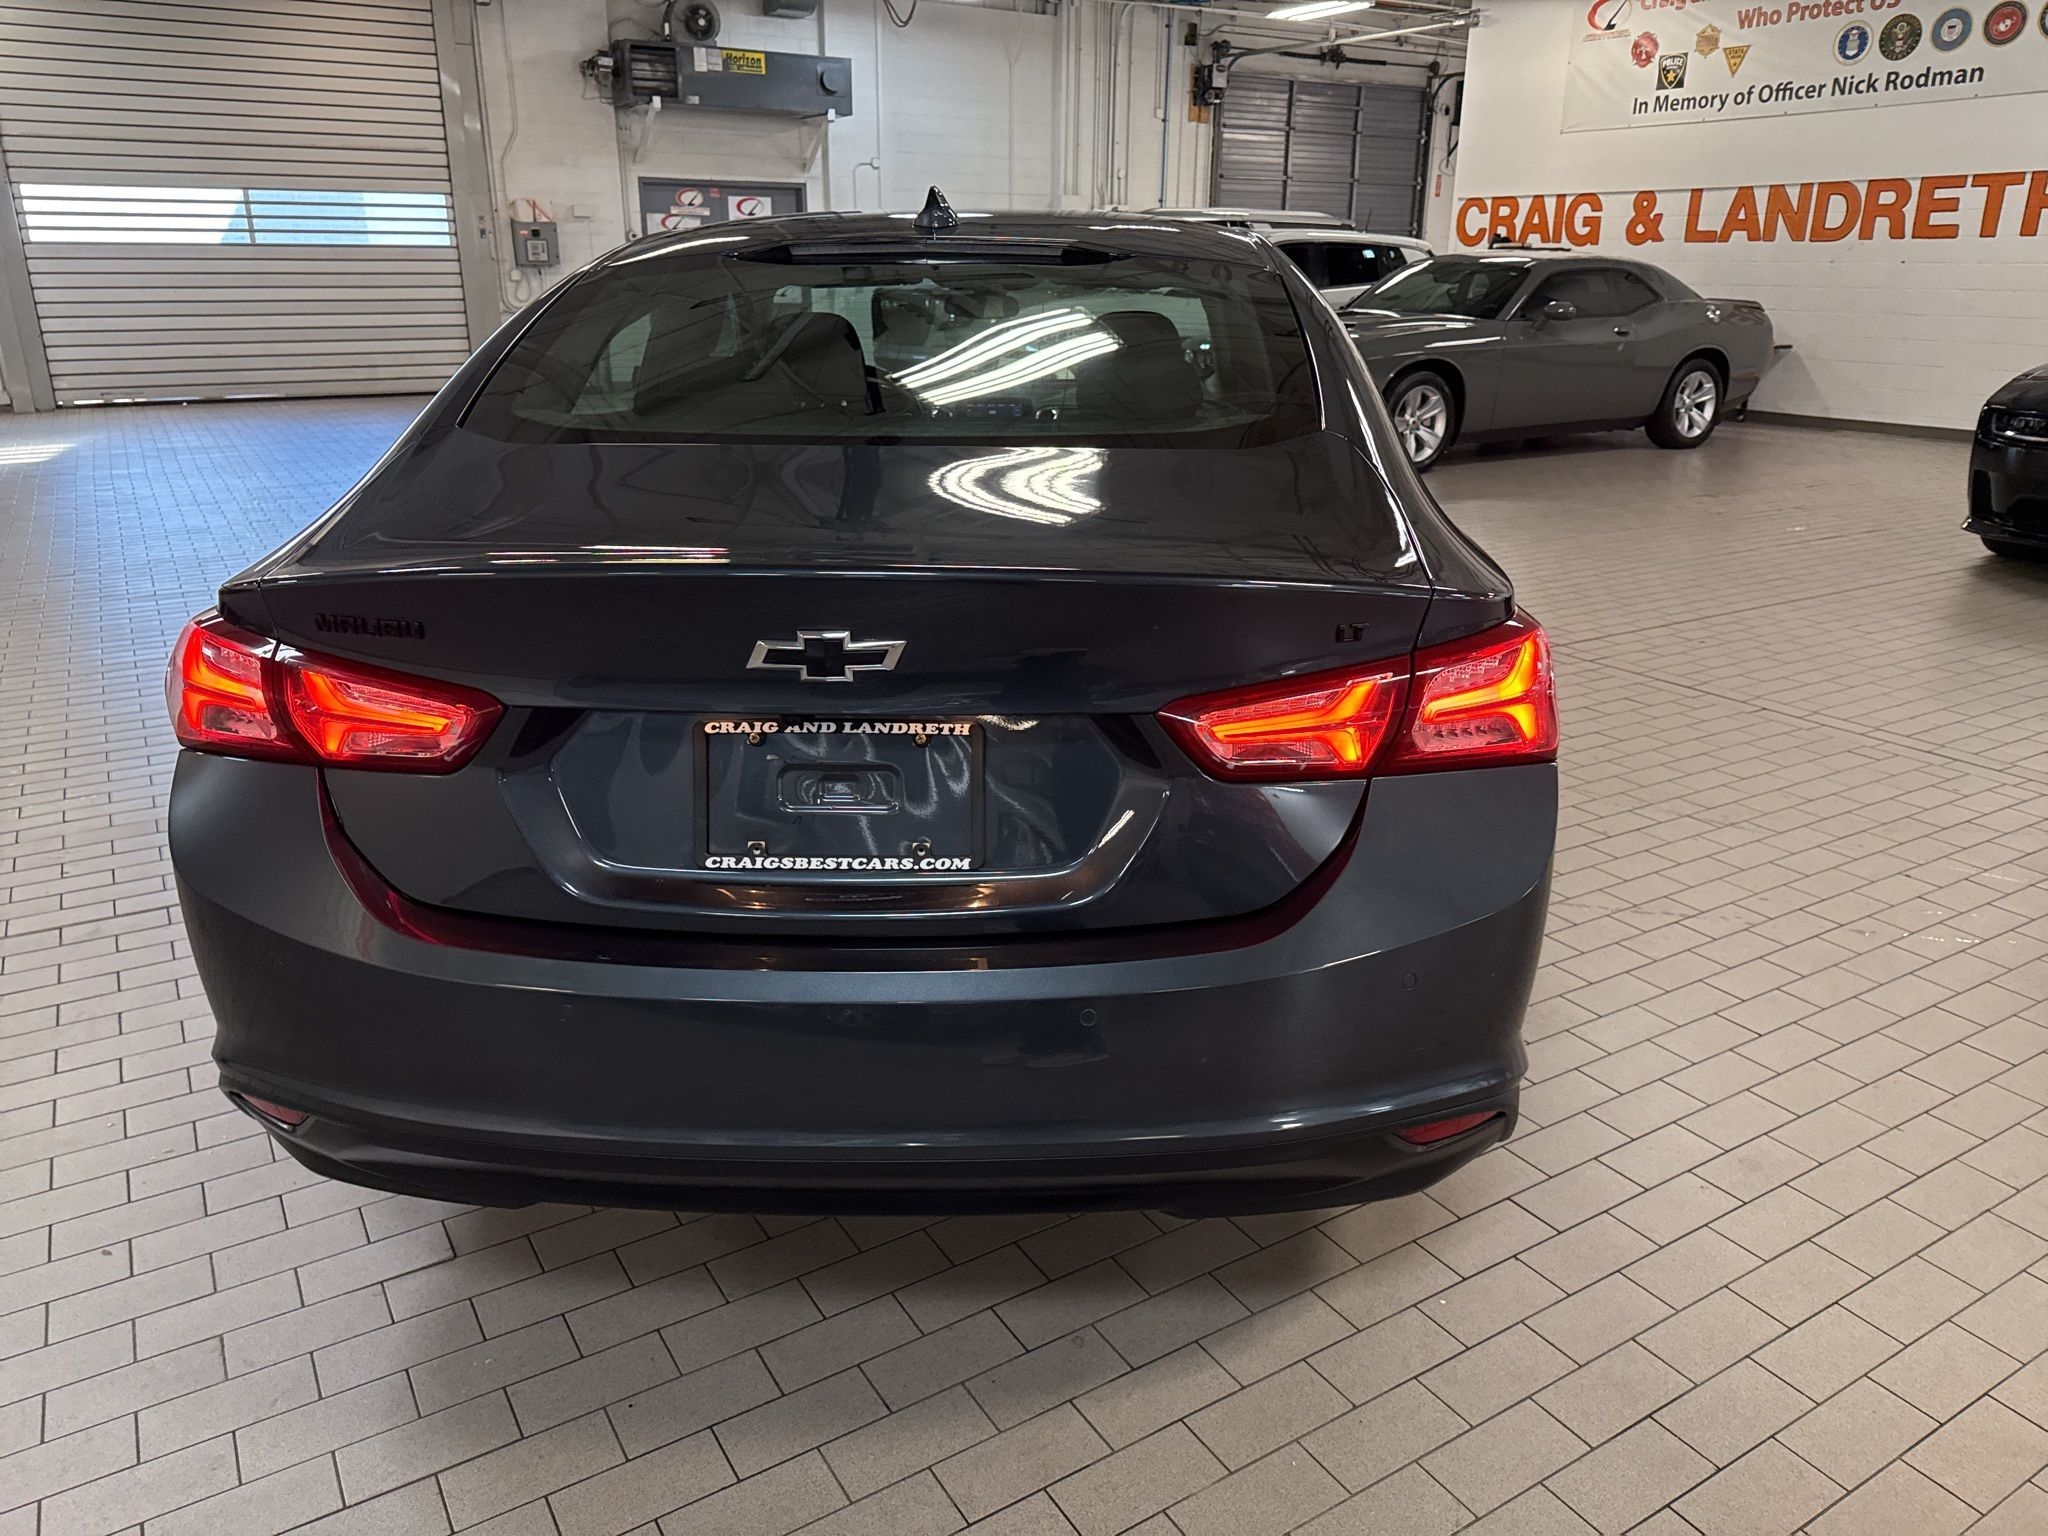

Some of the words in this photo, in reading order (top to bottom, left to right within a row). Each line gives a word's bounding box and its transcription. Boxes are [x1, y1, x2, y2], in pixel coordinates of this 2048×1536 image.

[1737, 6, 1782, 30] Who
[1786, 0, 1864, 23] Protect
[1662, 57, 1684, 67] POLICE
[1632, 97, 1648, 115] In
[1653, 92, 1729, 113] Memory
[1733, 84, 1756, 106] of
[1758, 80, 1826, 104] Officer
[1831, 72, 1880, 97] Nick
[1885, 66, 1984, 91] Rodman
[1456, 192, 1603, 247] CRAIG
[1625, 190, 1665, 246] &
[1335, 621, 1370, 644] LT
[704, 721, 779, 735] CRAIG
[784, 721, 837, 735] AND
[842, 722, 972, 737] LANDRETH
[704, 856, 972, 871] CRAIGSBESTCARS.COM
